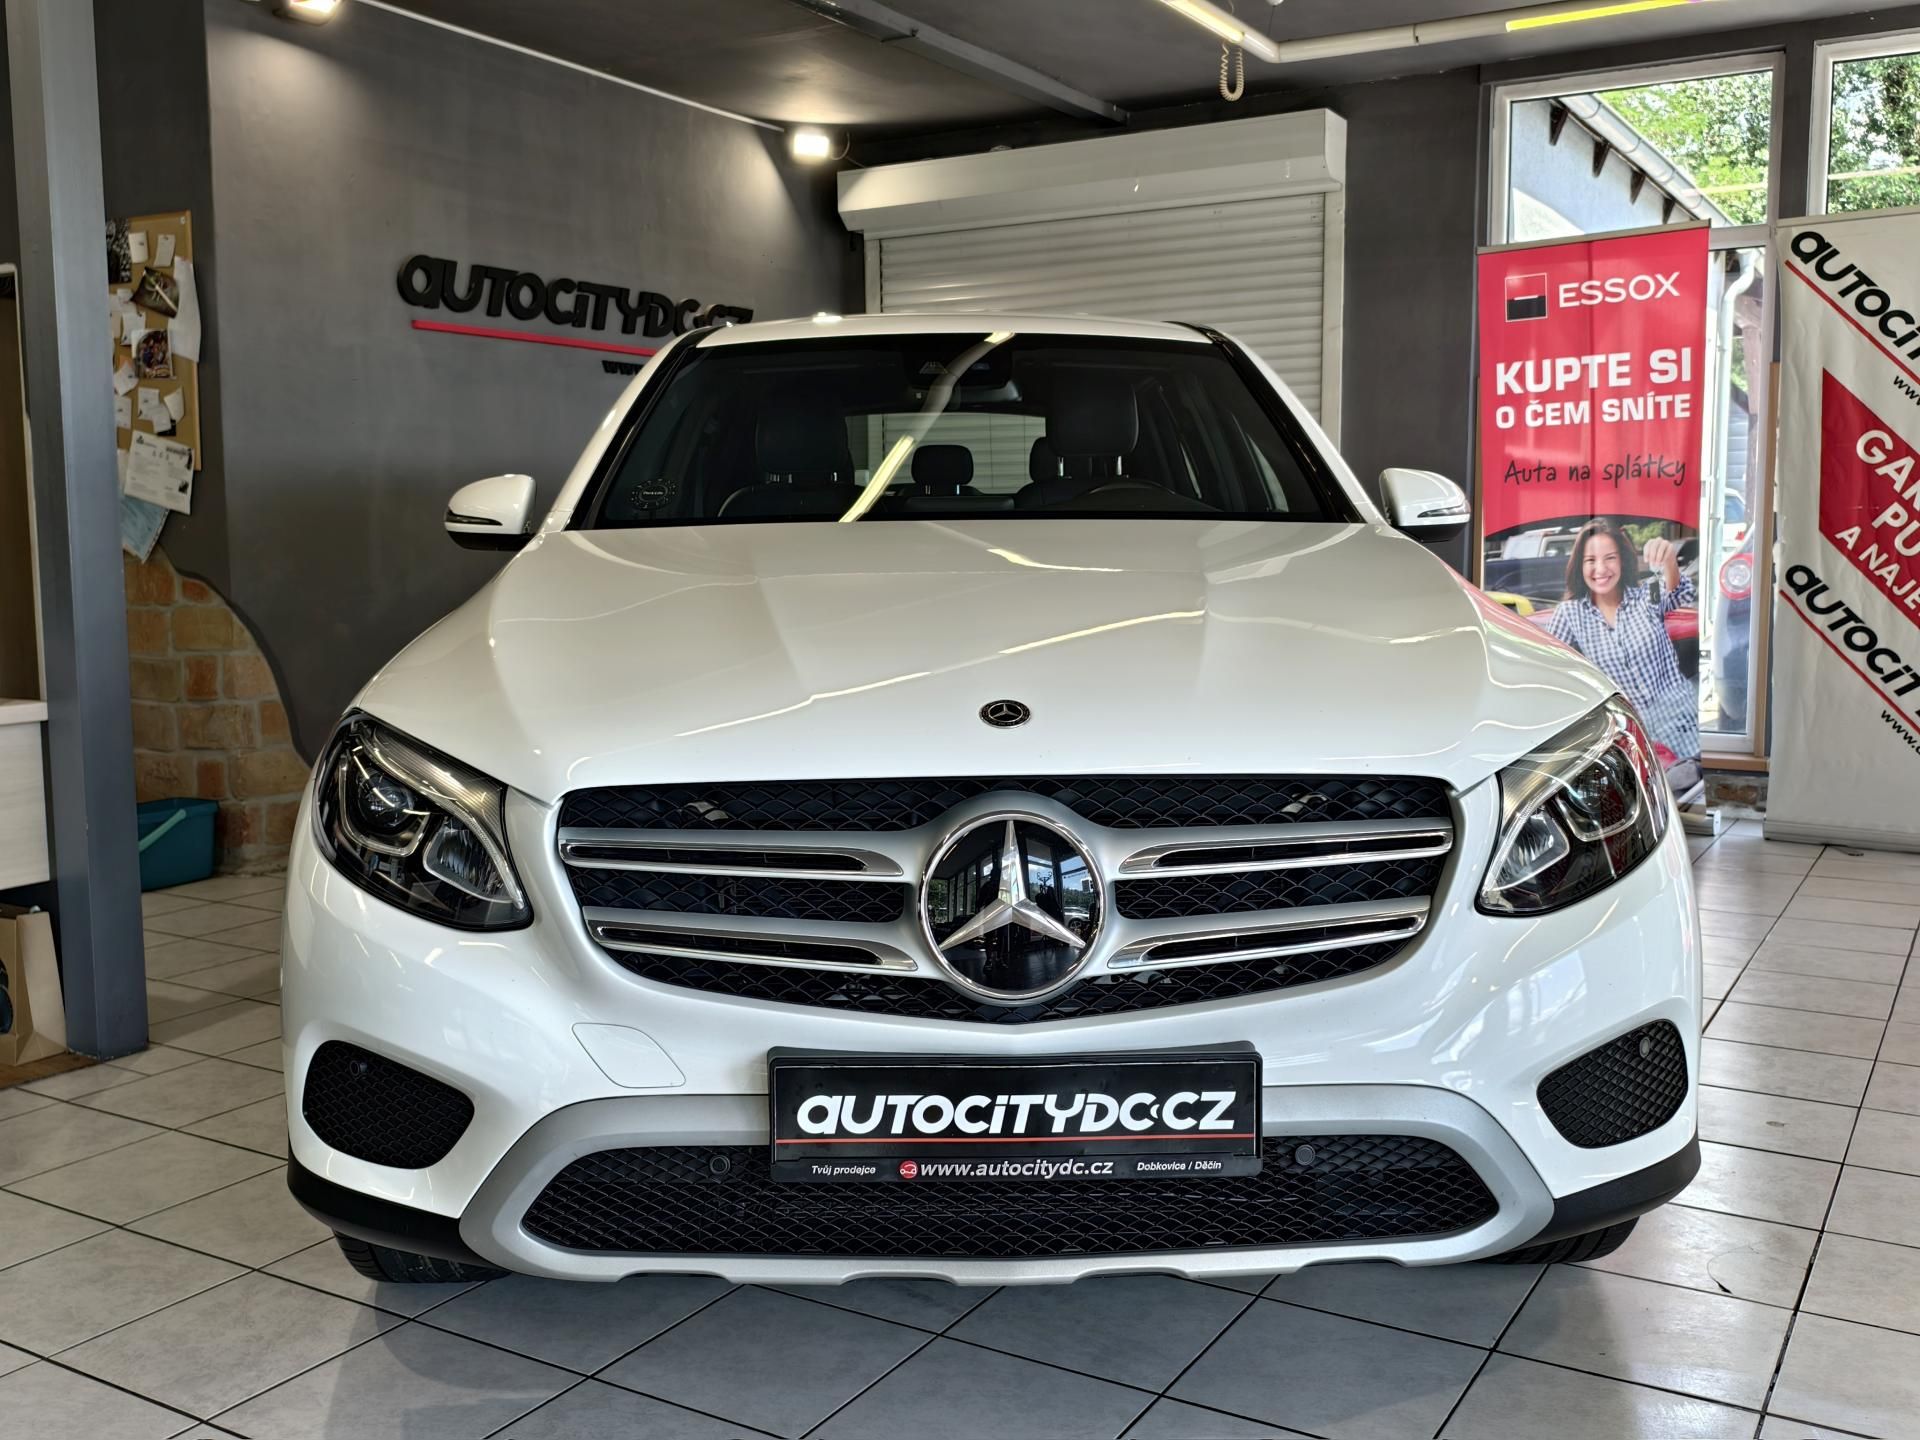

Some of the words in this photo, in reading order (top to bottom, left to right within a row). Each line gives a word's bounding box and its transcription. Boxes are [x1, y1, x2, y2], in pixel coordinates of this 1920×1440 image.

[1558, 271, 1680, 308] ESSOX
[1496, 352, 1631, 396] KUPTE
[1649, 347, 1692, 386] SI
[1496, 405, 1515, 429] O
[1525, 399, 1590, 428] ČEM
[1602, 391, 1691, 423] SNÍTE
[1504, 459, 1557, 484] Auta
[1569, 464, 1591, 480] na
[1602, 453, 1686, 488] splátky
[1834, 525, 1861, 550] A
[811, 1165, 832, 1176] Tvůj
[833, 1165, 876, 1177] prodejce
[920, 1158, 1114, 1180] www.autocitydc.cz
[1137, 1162, 1186, 1171] Dobkovice
[1194, 1160, 1222, 1171] Děčín
